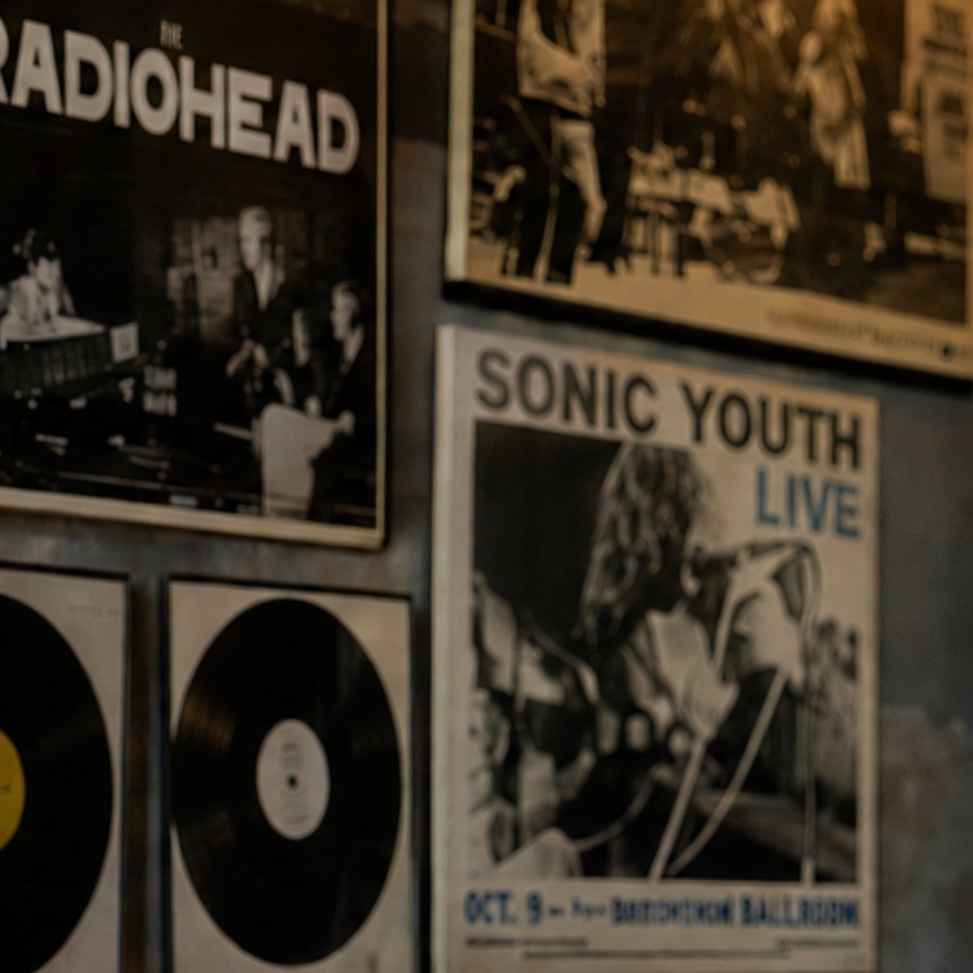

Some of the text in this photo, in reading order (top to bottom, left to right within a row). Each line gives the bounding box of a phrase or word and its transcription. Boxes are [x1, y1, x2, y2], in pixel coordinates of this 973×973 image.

[475, 348, 861, 469] SONIC YOUTH
[754, 466, 860, 539] LIVE
[464, 890, 518, 925] OCT.
[527, 890, 543, 926] 9
